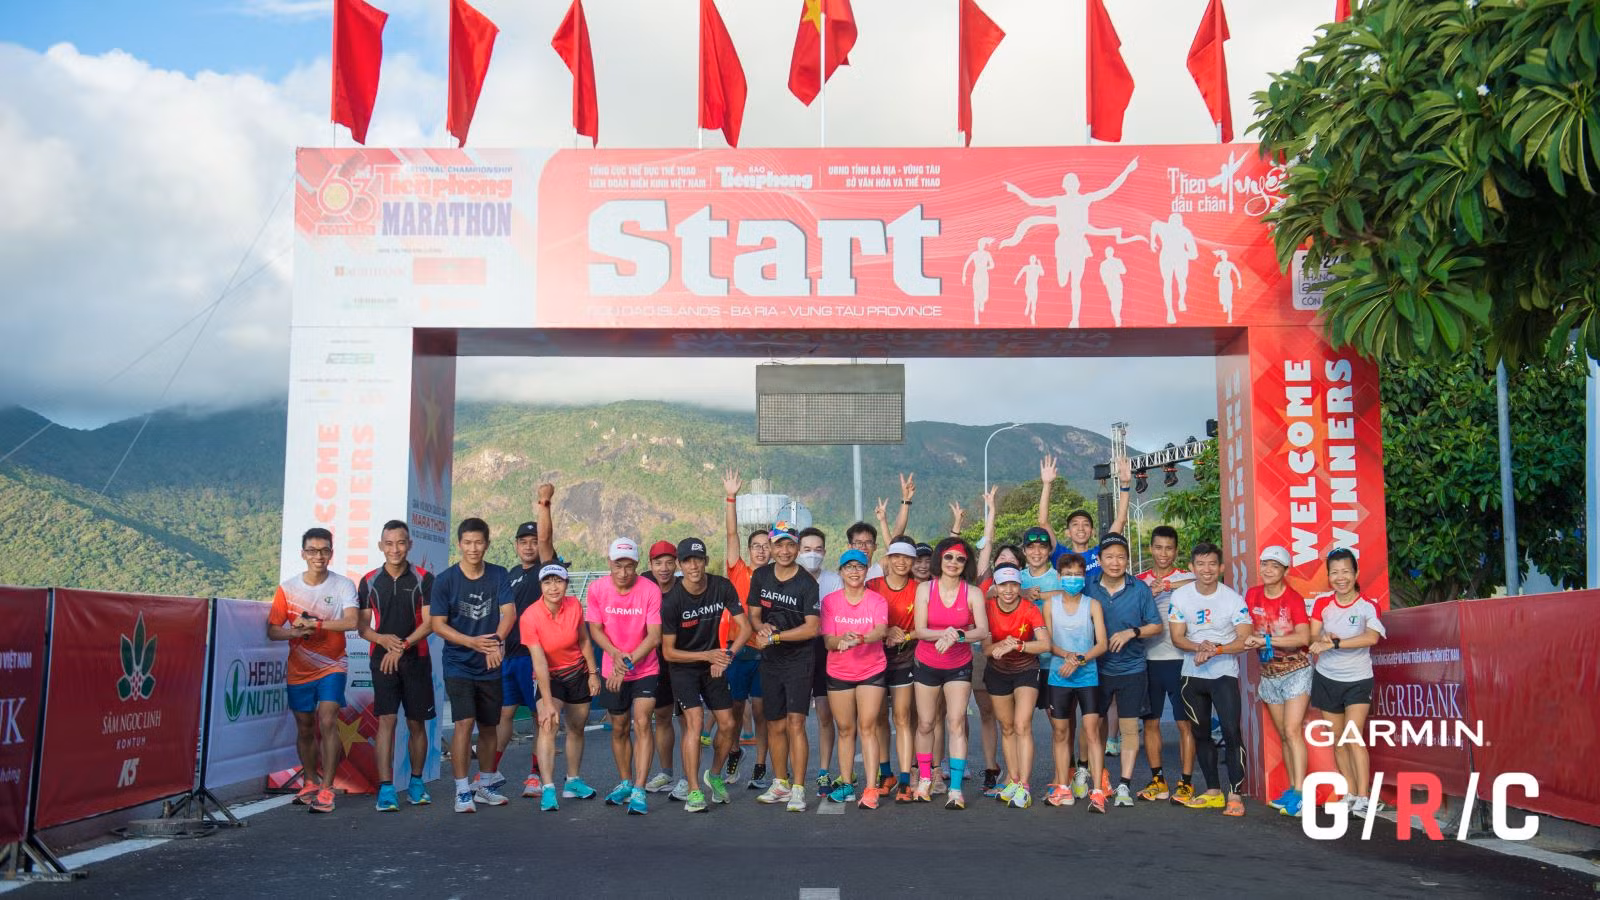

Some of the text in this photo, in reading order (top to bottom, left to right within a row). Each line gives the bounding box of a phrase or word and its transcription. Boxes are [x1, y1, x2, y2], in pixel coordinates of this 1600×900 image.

[1167, 167, 1207, 194] Theo
[382, 202, 512, 236] MARATHON
[587, 198, 942, 297] Start
[657, 305, 721, 316] ISLANDS
[730, 305, 752, 316] BA
[754, 305, 778, 316] RIA
[788, 305, 833, 316] VUNG
[836, 305, 865, 316] TAU
[867, 305, 943, 316] PROVINCE
[1284, 359, 1319, 568] WELCOME
[1324, 358, 1360, 560] WINNERS
[760, 588, 797, 606] GARMIN
[604, 606, 643, 616] GARMIN
[682, 602, 727, 620] GARMIN
[834, 614, 873, 625] GARMIN
[1376, 683, 1463, 719] AGRIBANK
[102, 710, 161, 735] SÂM NGỌC LINH
[116, 736, 146, 750] KONTUM
